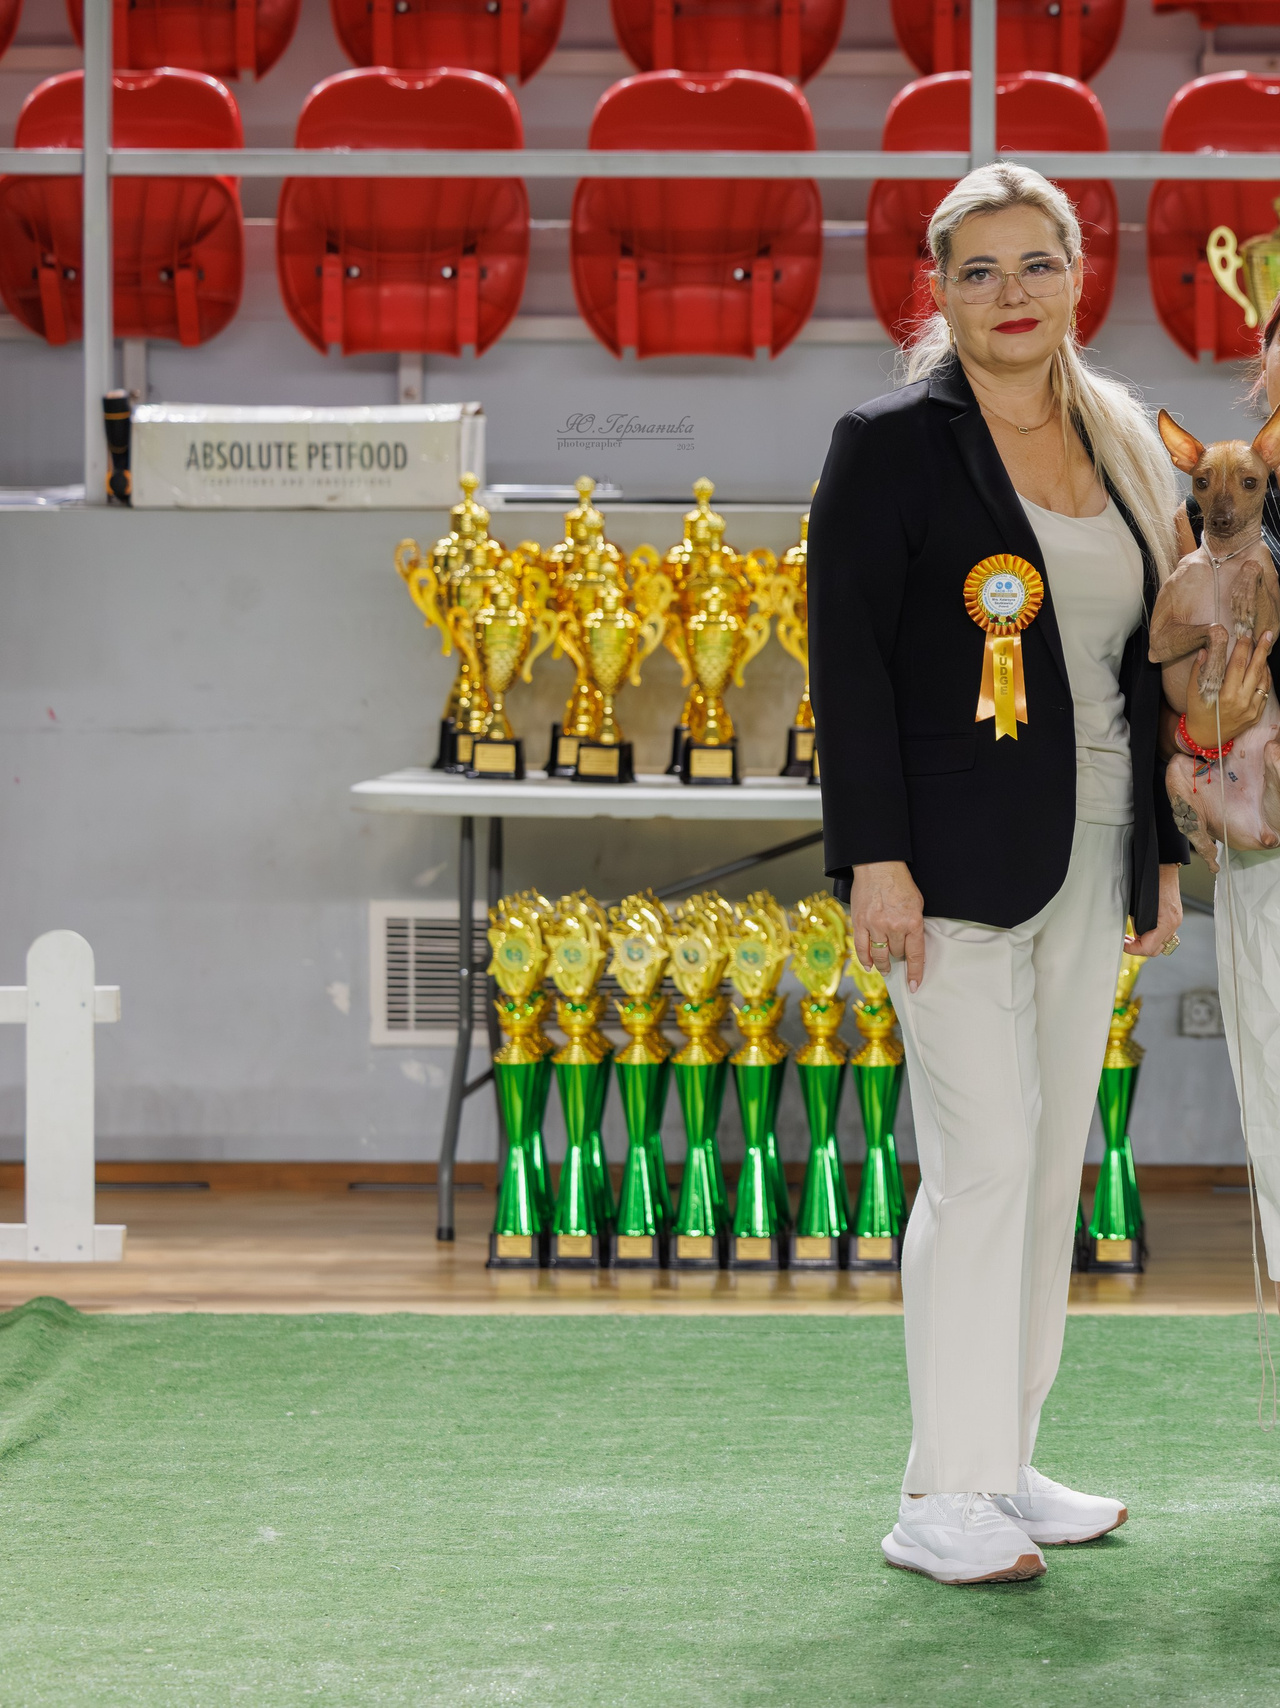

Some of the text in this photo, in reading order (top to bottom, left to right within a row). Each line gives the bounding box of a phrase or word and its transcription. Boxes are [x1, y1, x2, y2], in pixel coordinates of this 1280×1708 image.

[186, 440, 408, 471] ABSOLUTE PETFOOD
[999, 647, 1008, 695] JUDGE
